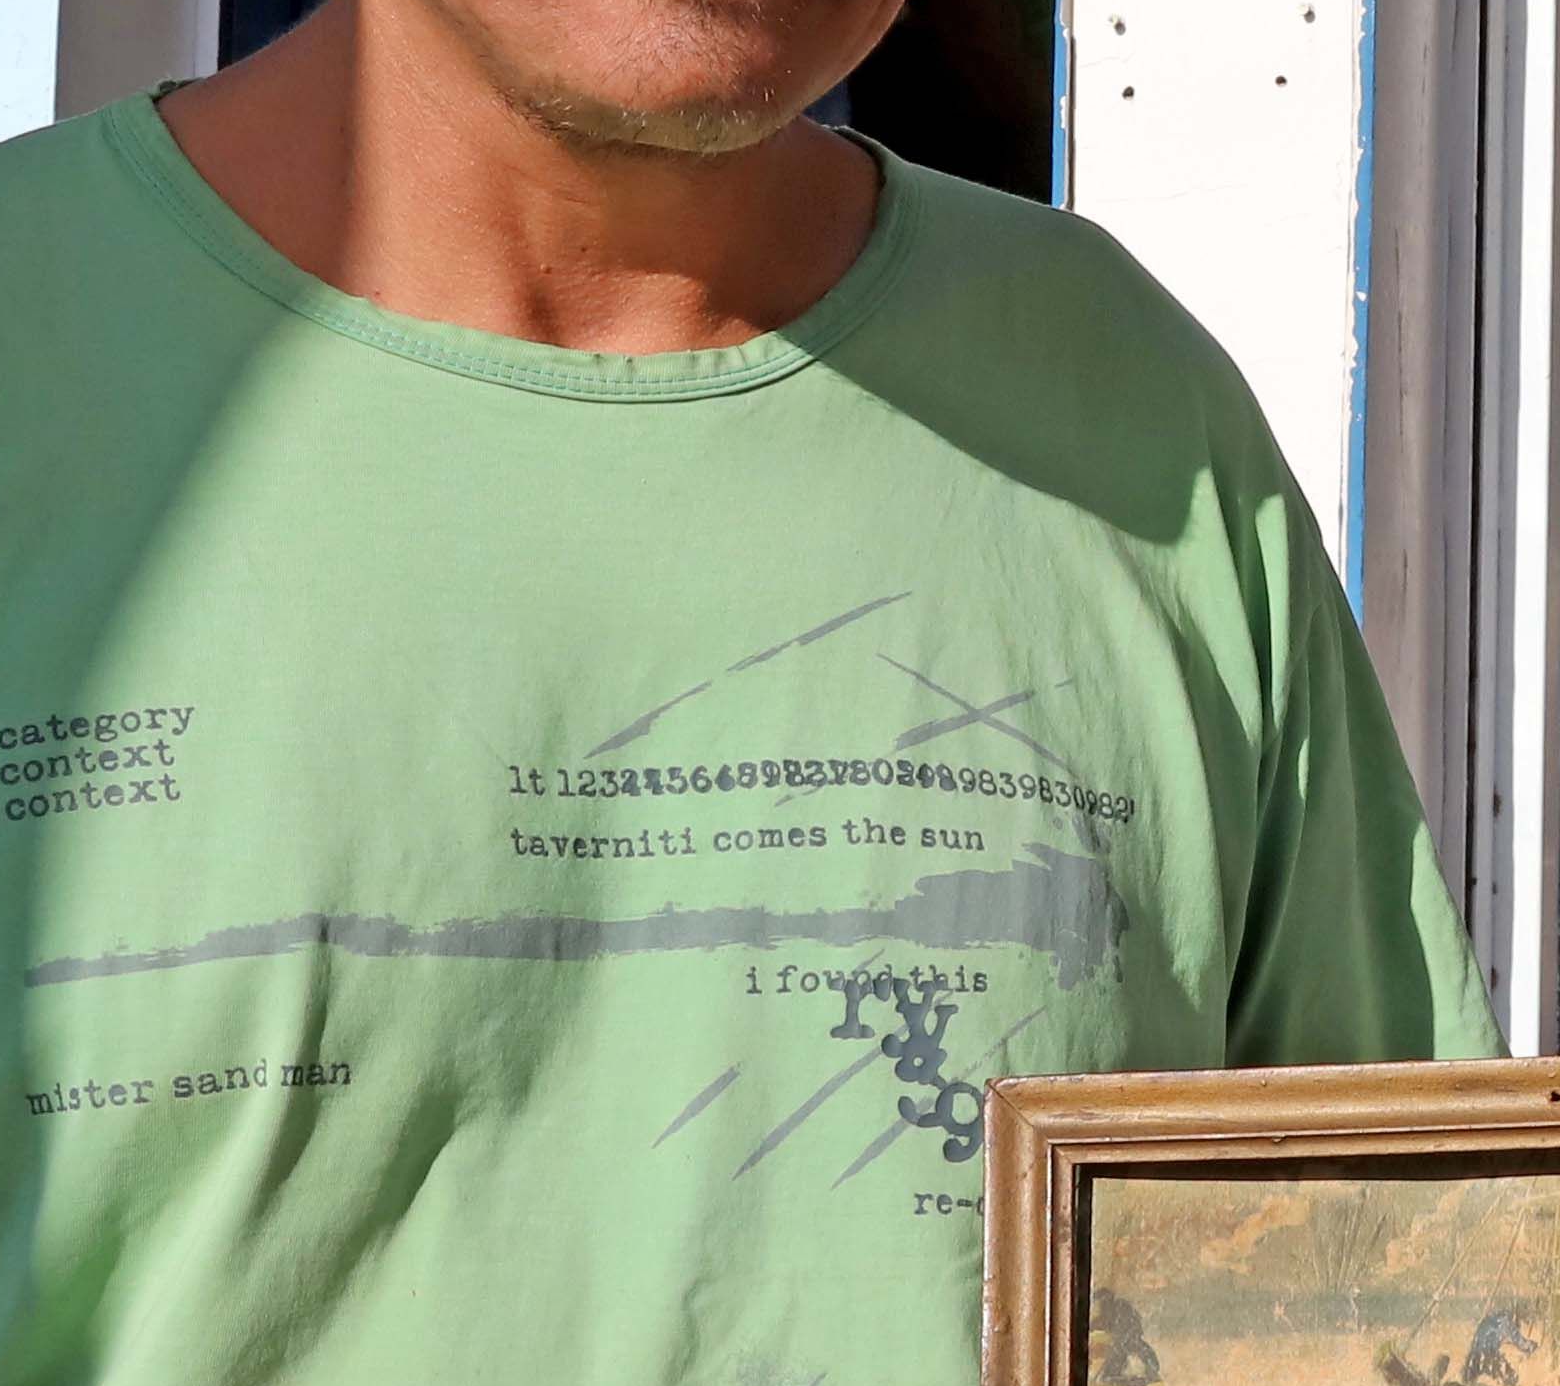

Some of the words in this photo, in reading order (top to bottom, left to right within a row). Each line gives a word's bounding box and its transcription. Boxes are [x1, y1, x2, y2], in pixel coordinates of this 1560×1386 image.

[4, 772, 182, 821] context
[510, 826, 697, 859] taverniti
[712, 825, 828, 852] comes
[841, 817, 907, 846] the
[920, 826, 985, 851] sun
[745, 965, 763, 994] i
[909, 964, 989, 993] this
[26, 1075, 154, 1117] mister
[172, 1059, 269, 1100] sand
[280, 1060, 353, 1089] man
